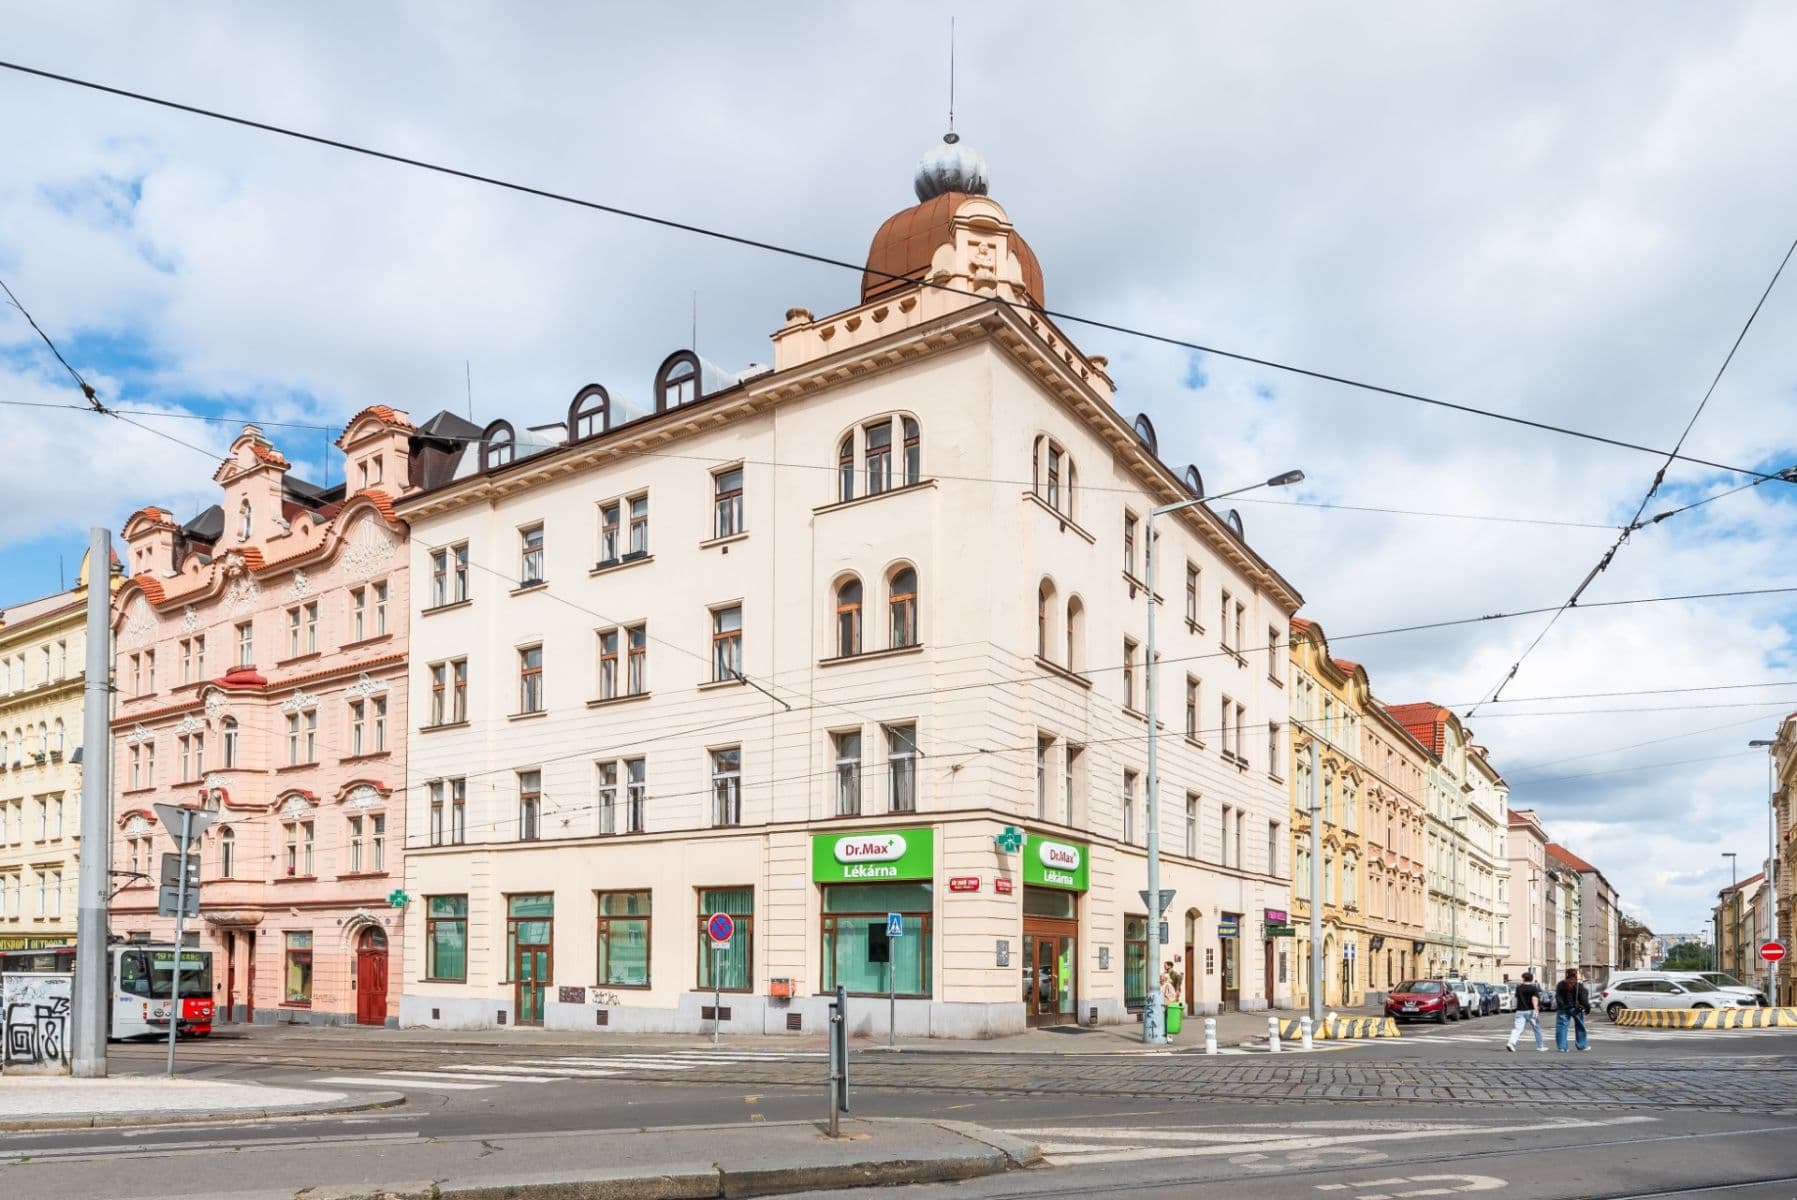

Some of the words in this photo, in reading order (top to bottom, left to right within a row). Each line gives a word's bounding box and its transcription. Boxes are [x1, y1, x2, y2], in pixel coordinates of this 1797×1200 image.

[845, 843, 888, 856] Dr.Max
[844, 864, 897, 878] Lékárna
[1044, 869, 1073, 885] Lékárna
